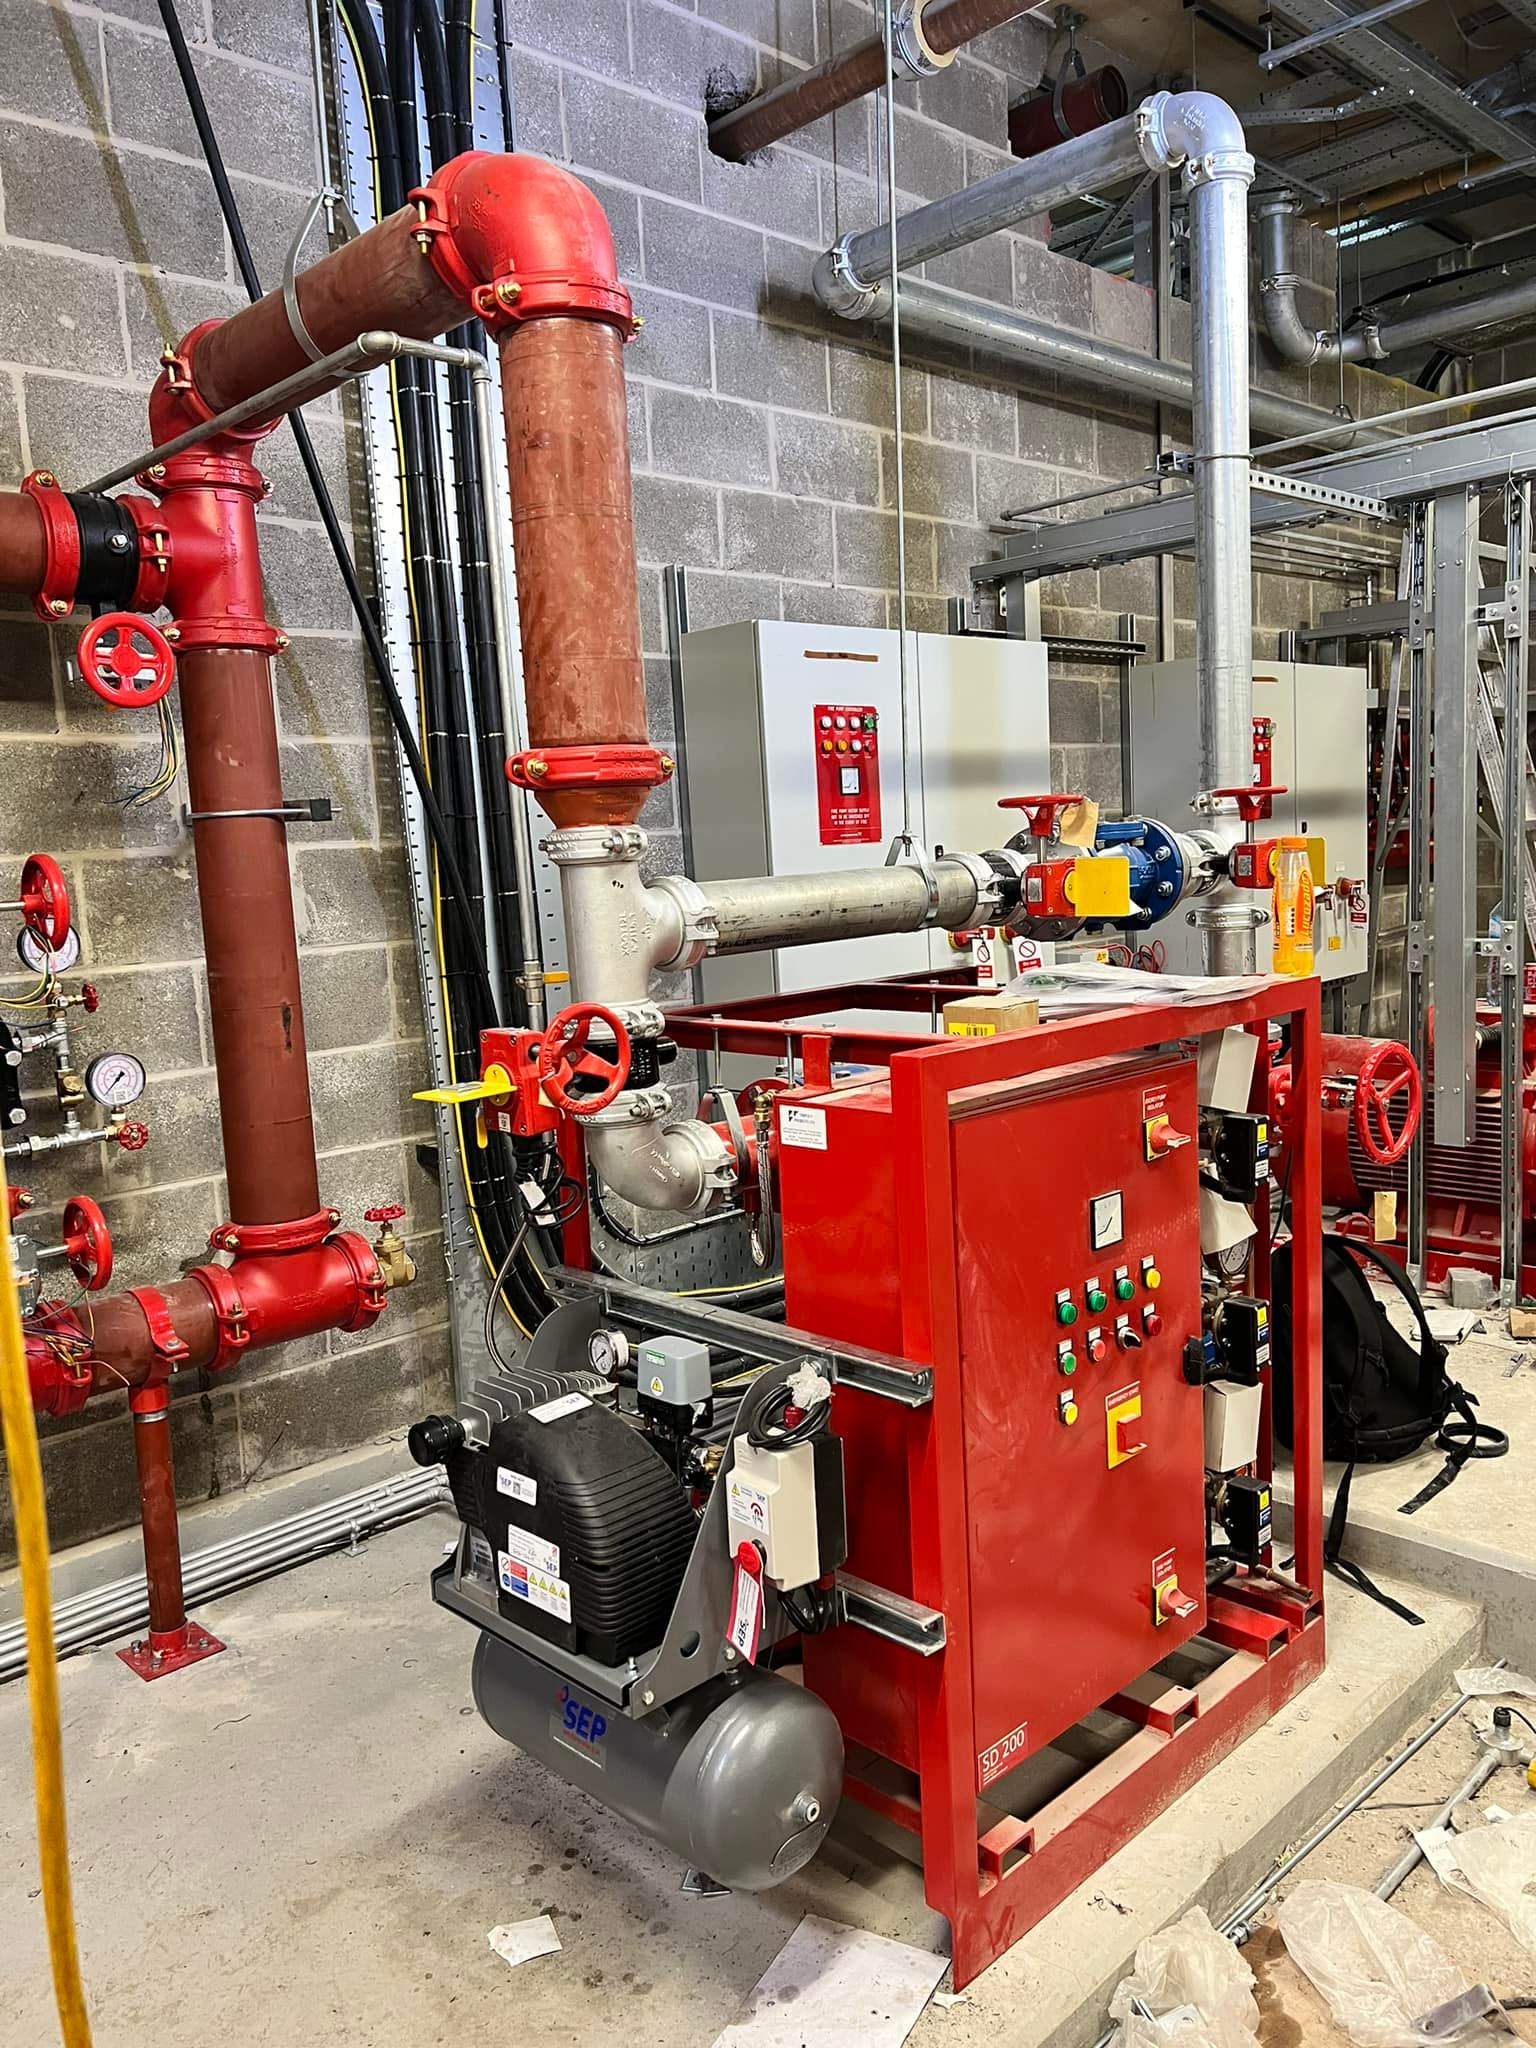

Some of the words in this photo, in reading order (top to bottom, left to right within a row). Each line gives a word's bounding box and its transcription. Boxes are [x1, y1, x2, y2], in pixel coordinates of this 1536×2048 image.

[1300, 870, 1310, 937] Lucozade
[738, 1619, 749, 1647] SEP
[564, 1700, 607, 1743] SEP
[982, 1748, 999, 1773] SD
[1002, 1729, 1025, 1759] 200
